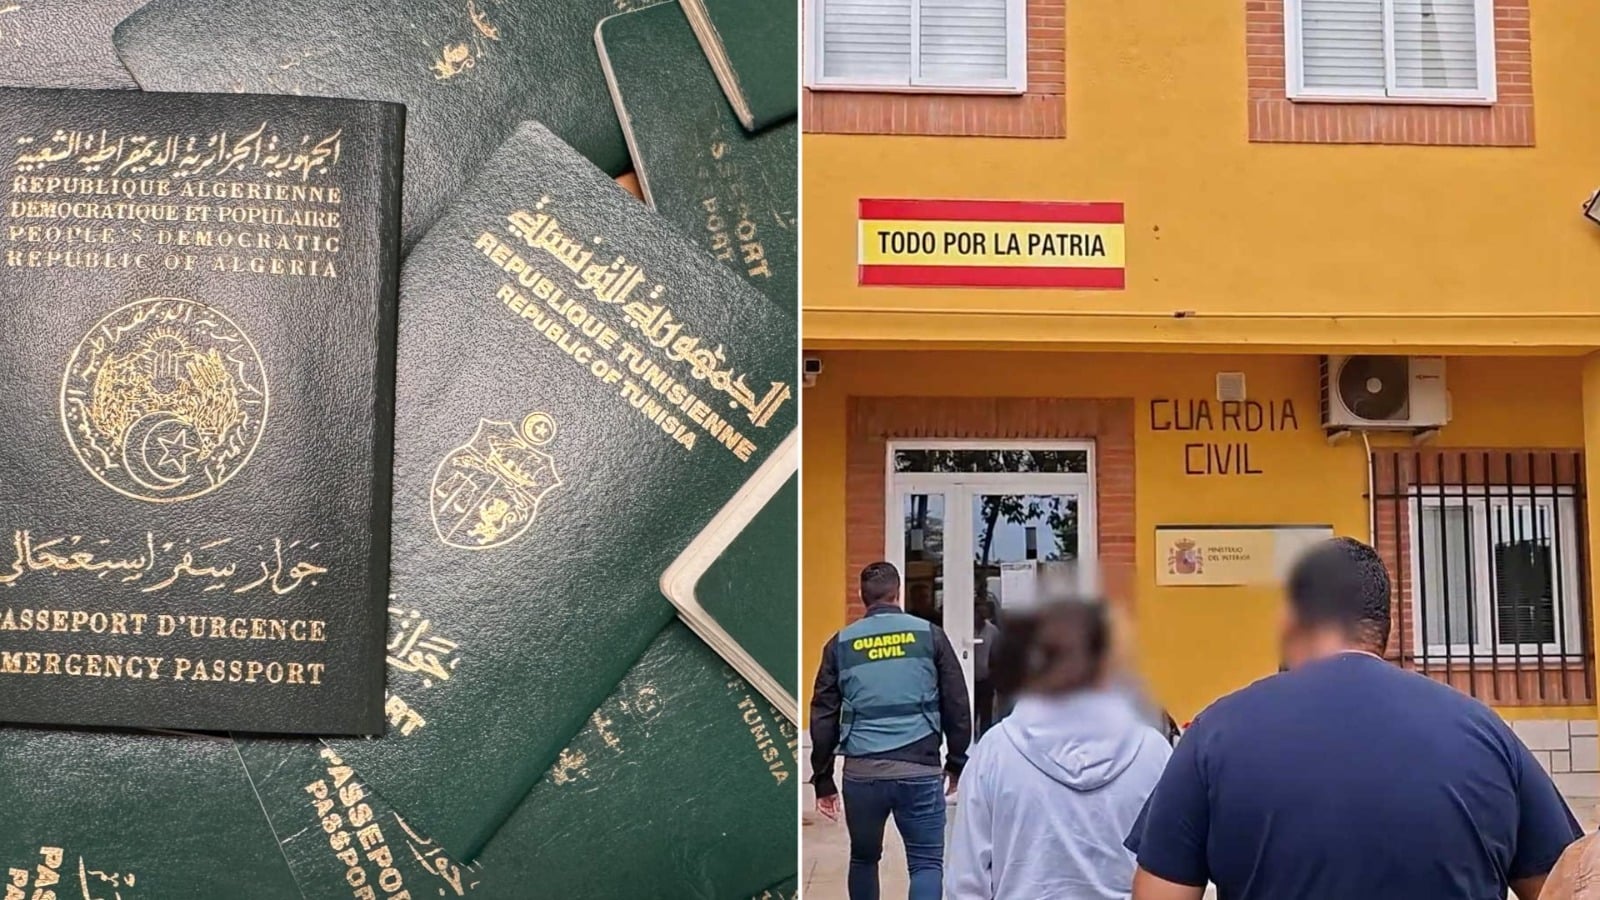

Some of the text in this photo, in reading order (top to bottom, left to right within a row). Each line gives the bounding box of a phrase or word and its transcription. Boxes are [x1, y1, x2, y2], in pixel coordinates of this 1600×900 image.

[12, 175, 342, 204] REPUBLIQUE ALGERIENNE
[10, 201, 341, 228] DEMOCRATIQUE ET POPULAIRE
[157, 229, 341, 252] DEMOCRATIC
[877, 231, 1106, 257] TODO POR LA PATRIA
[7, 249, 337, 278] REPUBLIC OF ALGERIA
[473, 231, 758, 463] REPUBLIQUE TUNISIENNE
[496, 283, 698, 451] REPUBLIC OF TUNISIA
[1150, 398, 1298, 432] GUARDIA
[1184, 443, 1263, 475] CIVIL
[0, 607, 327, 643] ASSEPORT D'URGENCE
[853, 632, 916, 651] GUARDIA
[868, 646, 906, 660] CIVIL
[174, 657, 325, 685] PASSPORT
